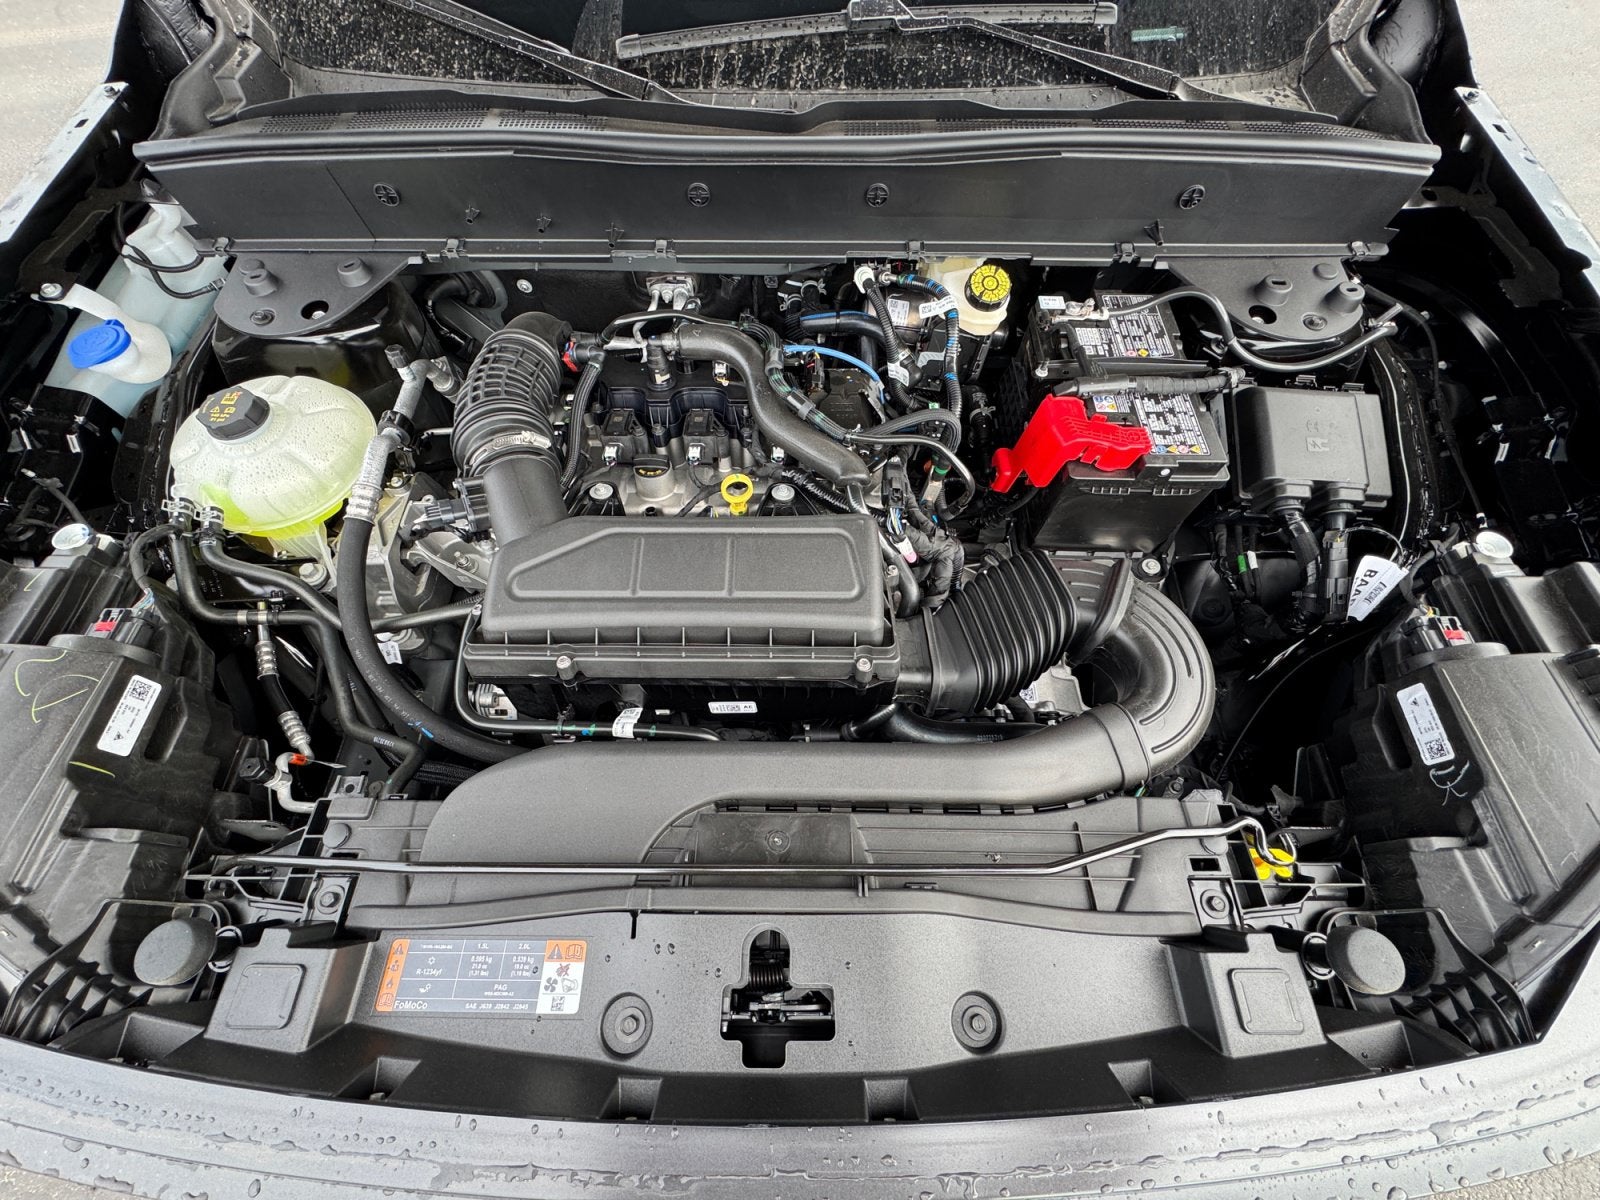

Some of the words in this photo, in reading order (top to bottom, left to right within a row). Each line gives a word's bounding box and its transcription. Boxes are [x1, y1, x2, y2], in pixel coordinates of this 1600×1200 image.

[415, 968, 443, 976] R-1234yf
[493, 983, 508, 991] PAG
[394, 1000, 428, 1009] FoMoCo
[465, 1002, 478, 1010] SAE
